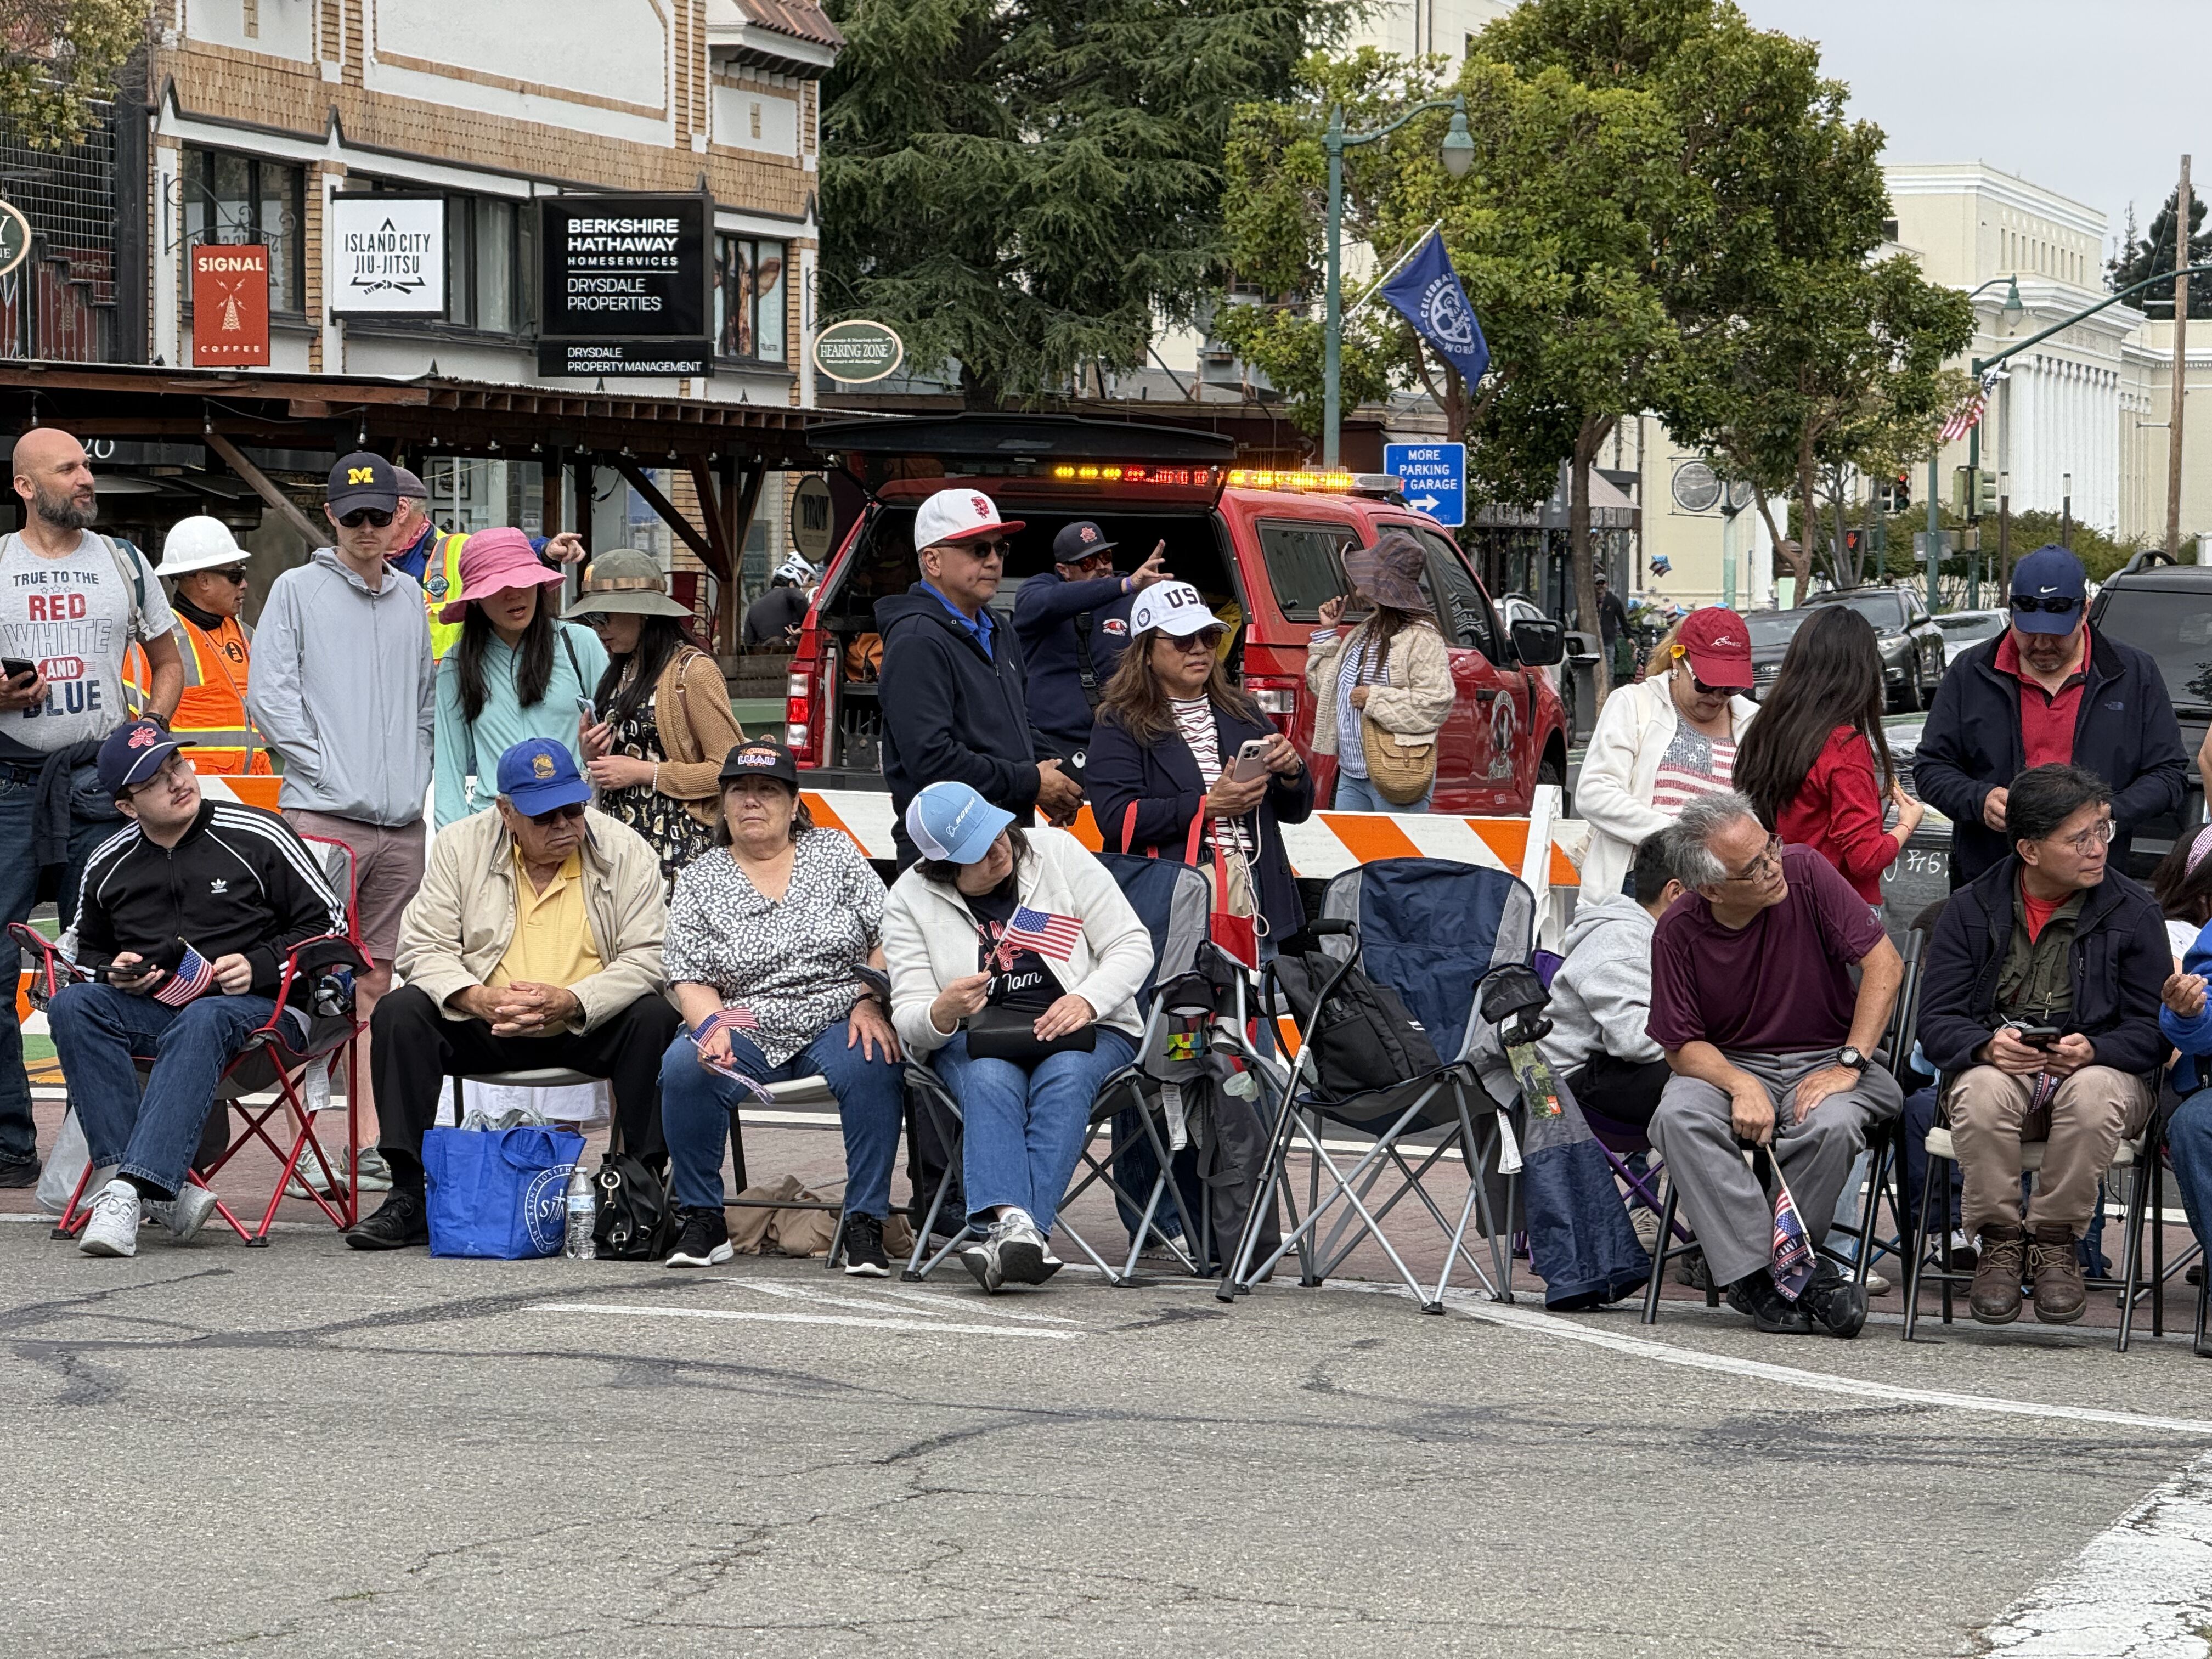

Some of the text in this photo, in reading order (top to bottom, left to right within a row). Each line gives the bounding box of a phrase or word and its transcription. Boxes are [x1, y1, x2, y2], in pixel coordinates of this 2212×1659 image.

[568, 219, 680, 233] BERKSHIRE
[345, 233, 430, 252] ISLAND CITY
[568, 237, 679, 251] HATHAWAY
[198, 257, 264, 272] SIGNAL
[355, 255, 419, 274] JIU-JITSU
[568, 257, 679, 266] HOMESERVICES
[568, 278, 646, 292] DRYSDALE
[568, 296, 662, 311] PROPERTIES
[567, 347, 623, 358] DRYSDALE
[820, 344, 888, 357] HEARING ZONE
[567, 362, 702, 372] PROPERTY MANAGEMENT
[1408, 449, 1441, 460] MORE
[348, 467, 374, 485] M
[1399, 465, 1450, 476] PARKING
[1410, 479, 1458, 490] GARAGE
[13, 571, 99, 587] TRUE TO THE
[29, 593, 86, 621] RED
[3, 619, 112, 659] WHITE
[46, 659, 78, 679] AND
[738, 755, 776, 766] LUAU
[955, 795, 975, 825] BOEING
[538, 1167, 572, 1184] JOSEPH
[528, 1187, 538, 1216] SAINT
